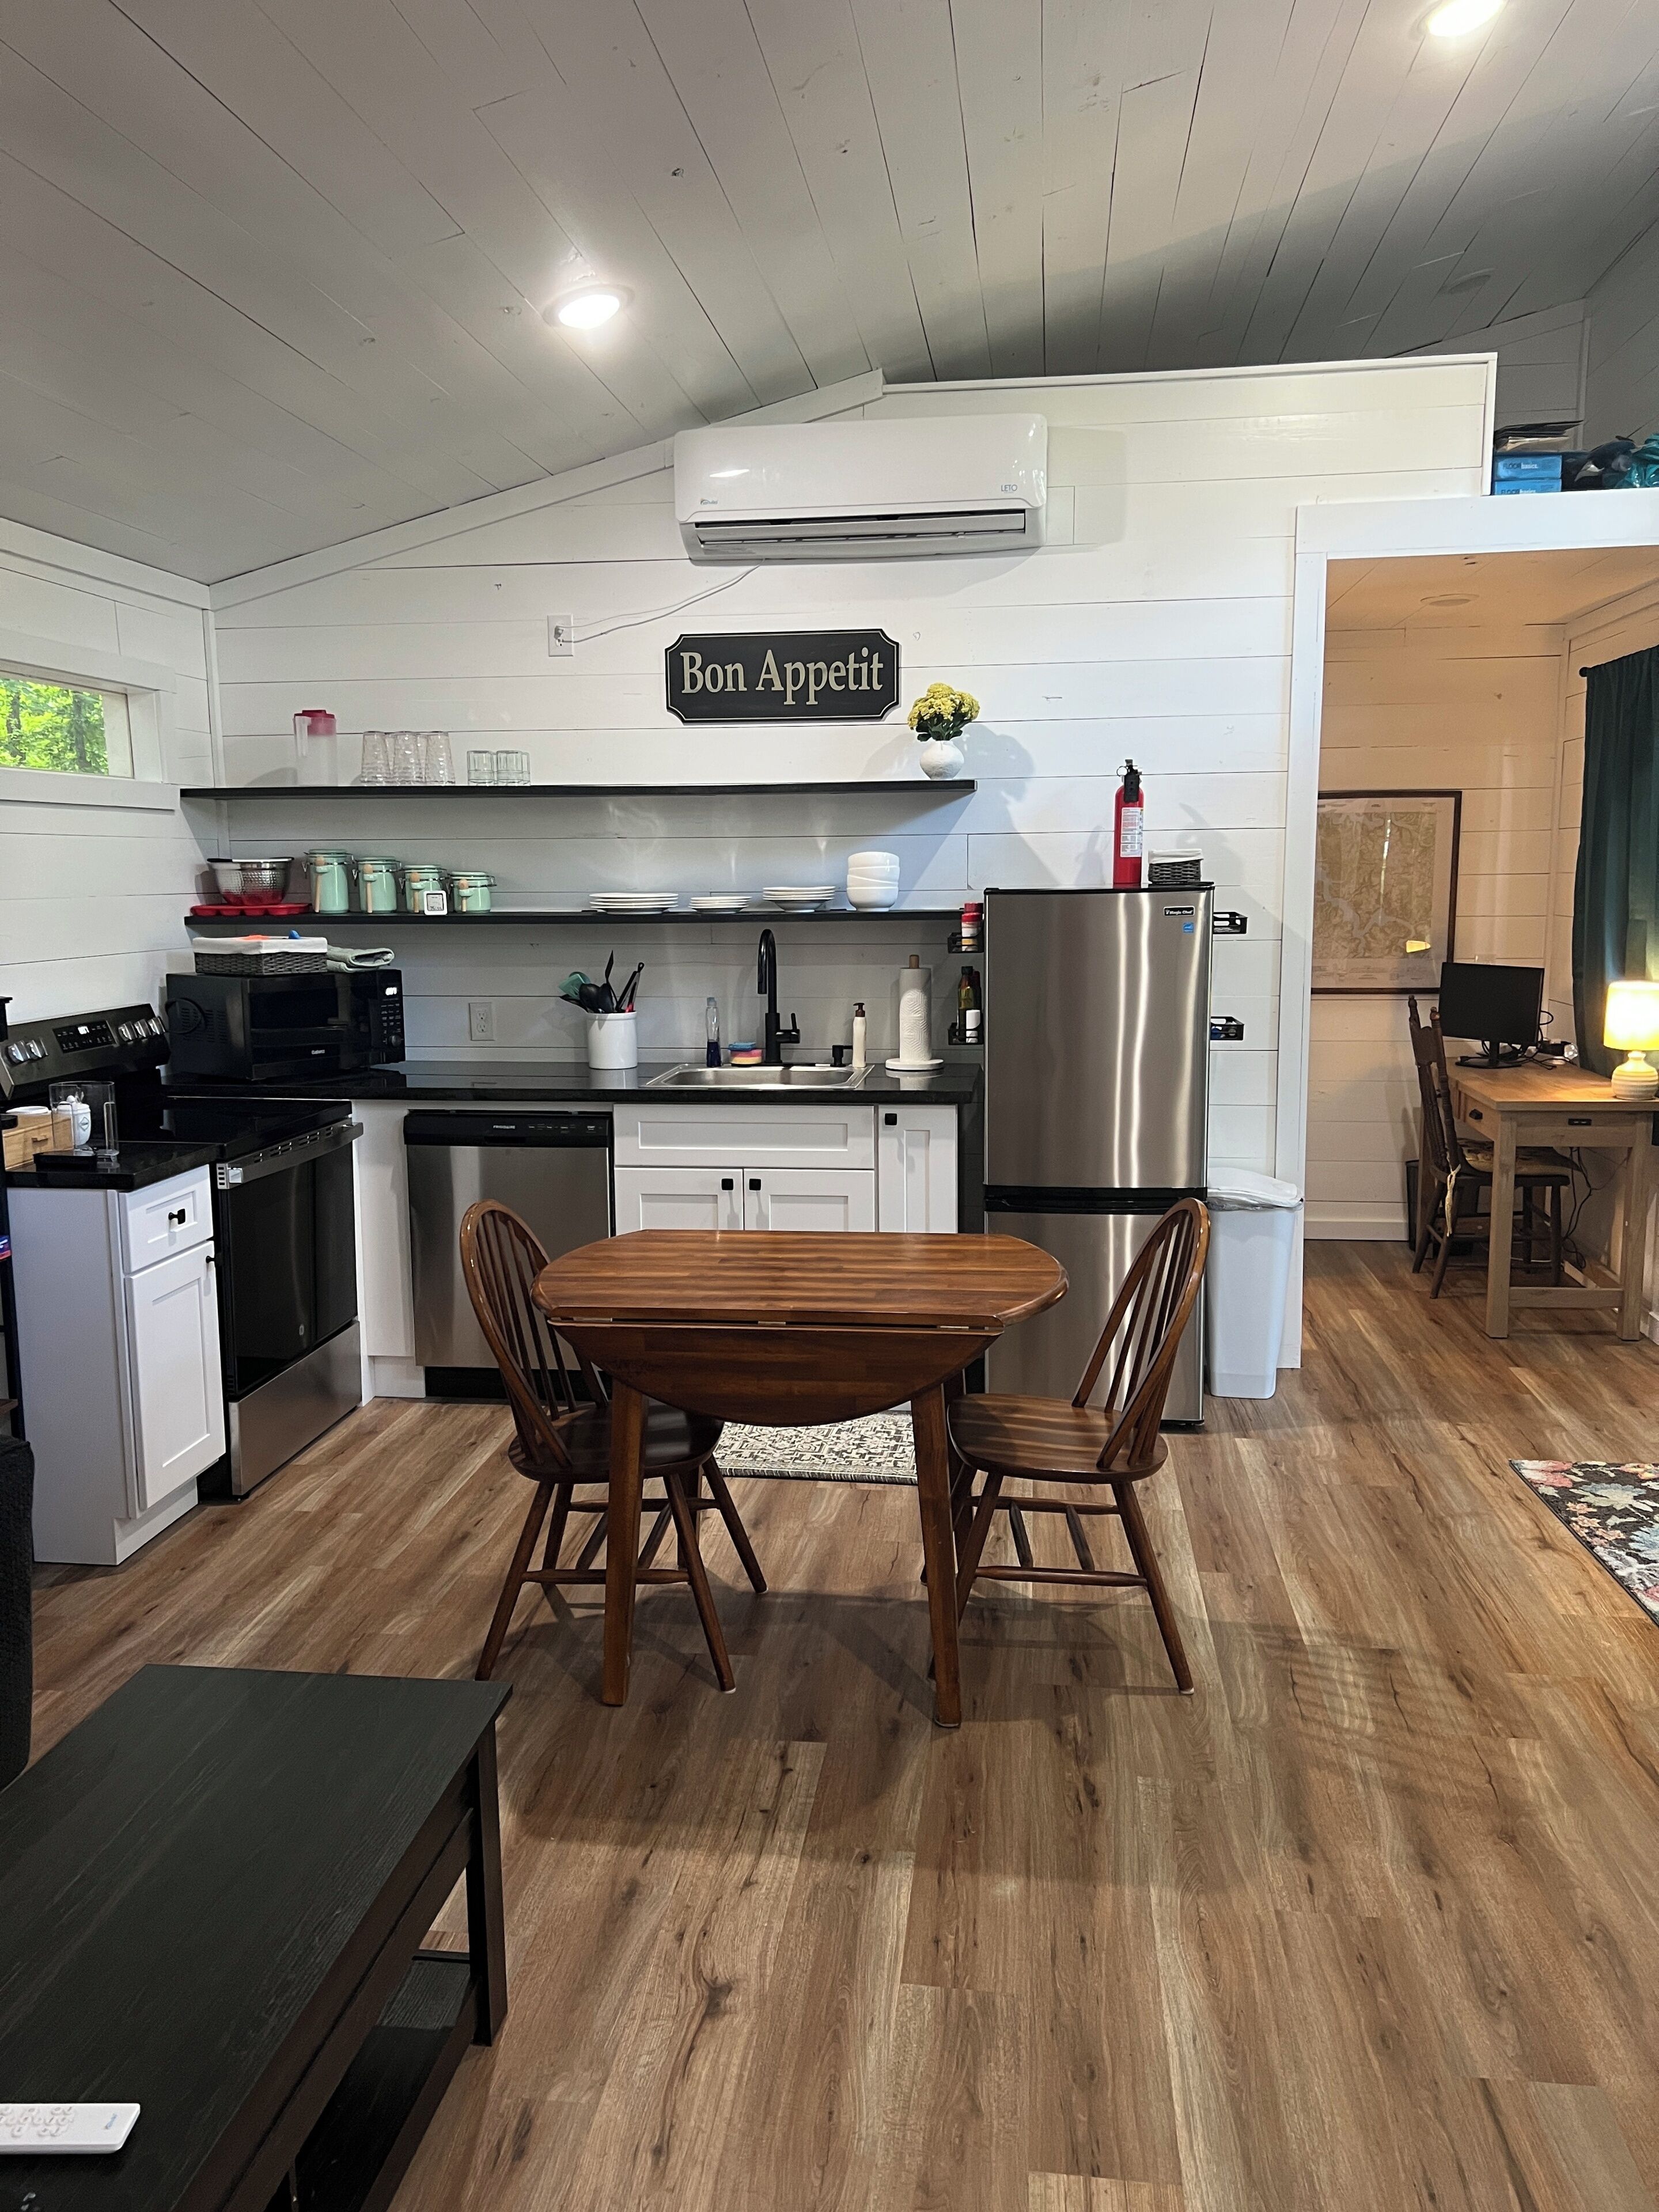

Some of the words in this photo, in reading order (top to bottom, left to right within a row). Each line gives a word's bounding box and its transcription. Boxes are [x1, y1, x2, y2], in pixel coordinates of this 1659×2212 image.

[1001, 484, 1018, 492] LETO
[680, 652, 747, 694] Bon
[755, 646, 884, 705] Appetit
